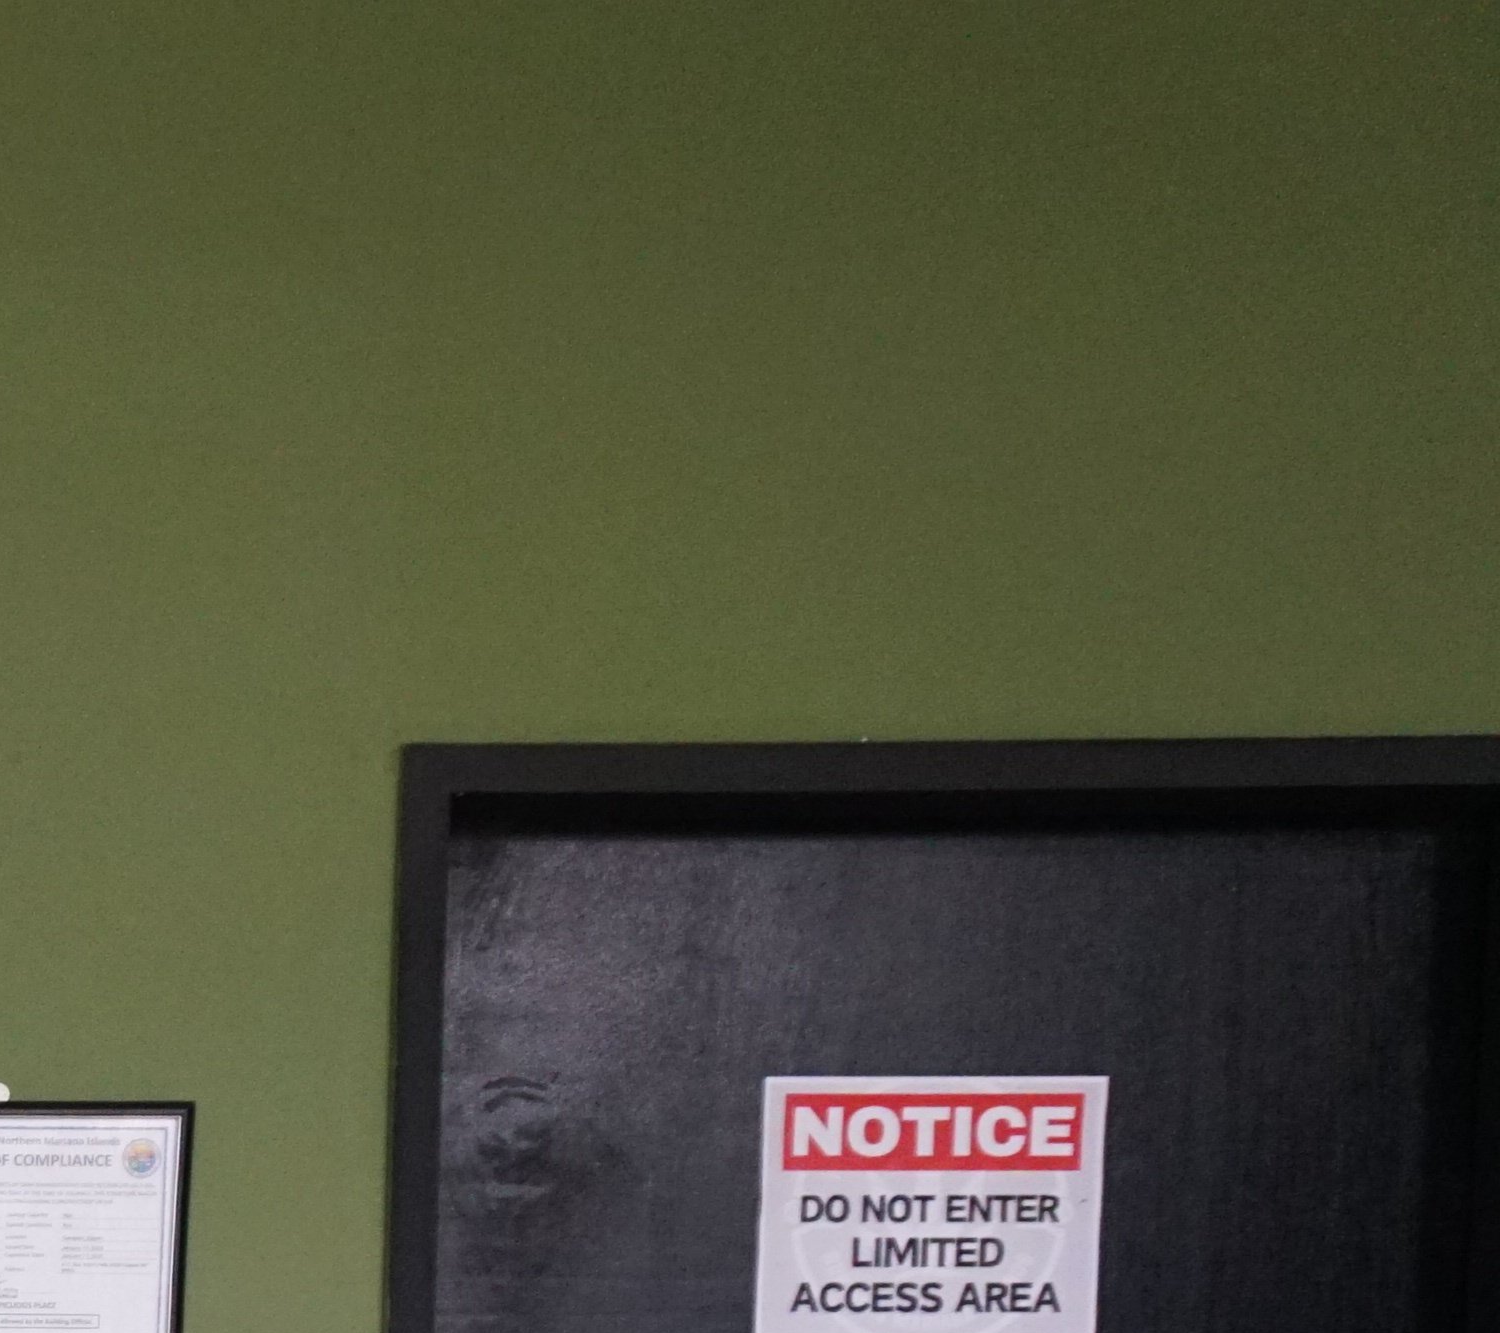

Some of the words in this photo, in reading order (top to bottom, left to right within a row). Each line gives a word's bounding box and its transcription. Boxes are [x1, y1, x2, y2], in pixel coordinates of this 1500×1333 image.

[791, 1105, 1076, 1158] NOTICE
[13, 1152, 113, 1167] COMPLIANCE
[799, 1194, 850, 1223] DO
[861, 1195, 936, 1223] NOT
[946, 1195, 1059, 1223] ENTER
[852, 1238, 1005, 1268] LIMITED
[791, 1282, 943, 1313] ACCESS
[955, 1282, 1061, 1313] AREA
